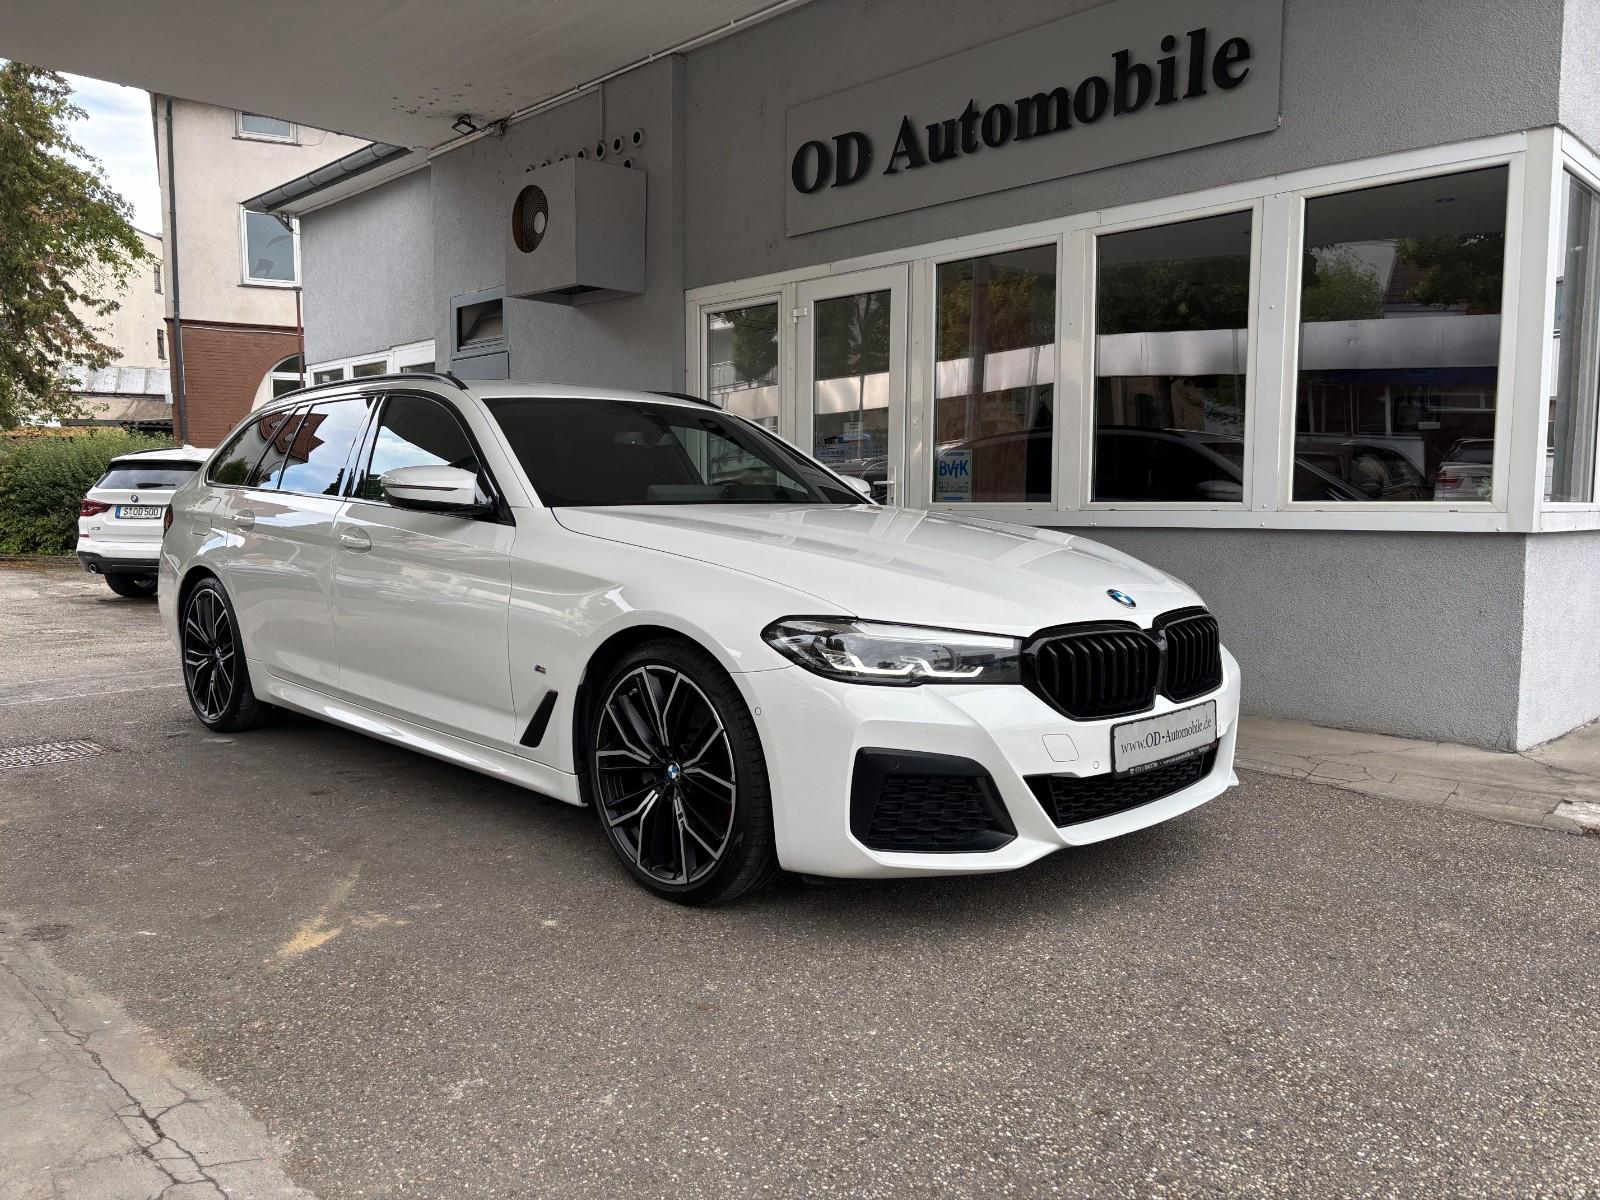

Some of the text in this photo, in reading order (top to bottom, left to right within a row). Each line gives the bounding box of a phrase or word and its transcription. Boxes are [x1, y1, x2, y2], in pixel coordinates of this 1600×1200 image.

[791, 27, 1251, 194] OD Automobile
[1120, 714, 1212, 755] www.OD-Automobile.de
